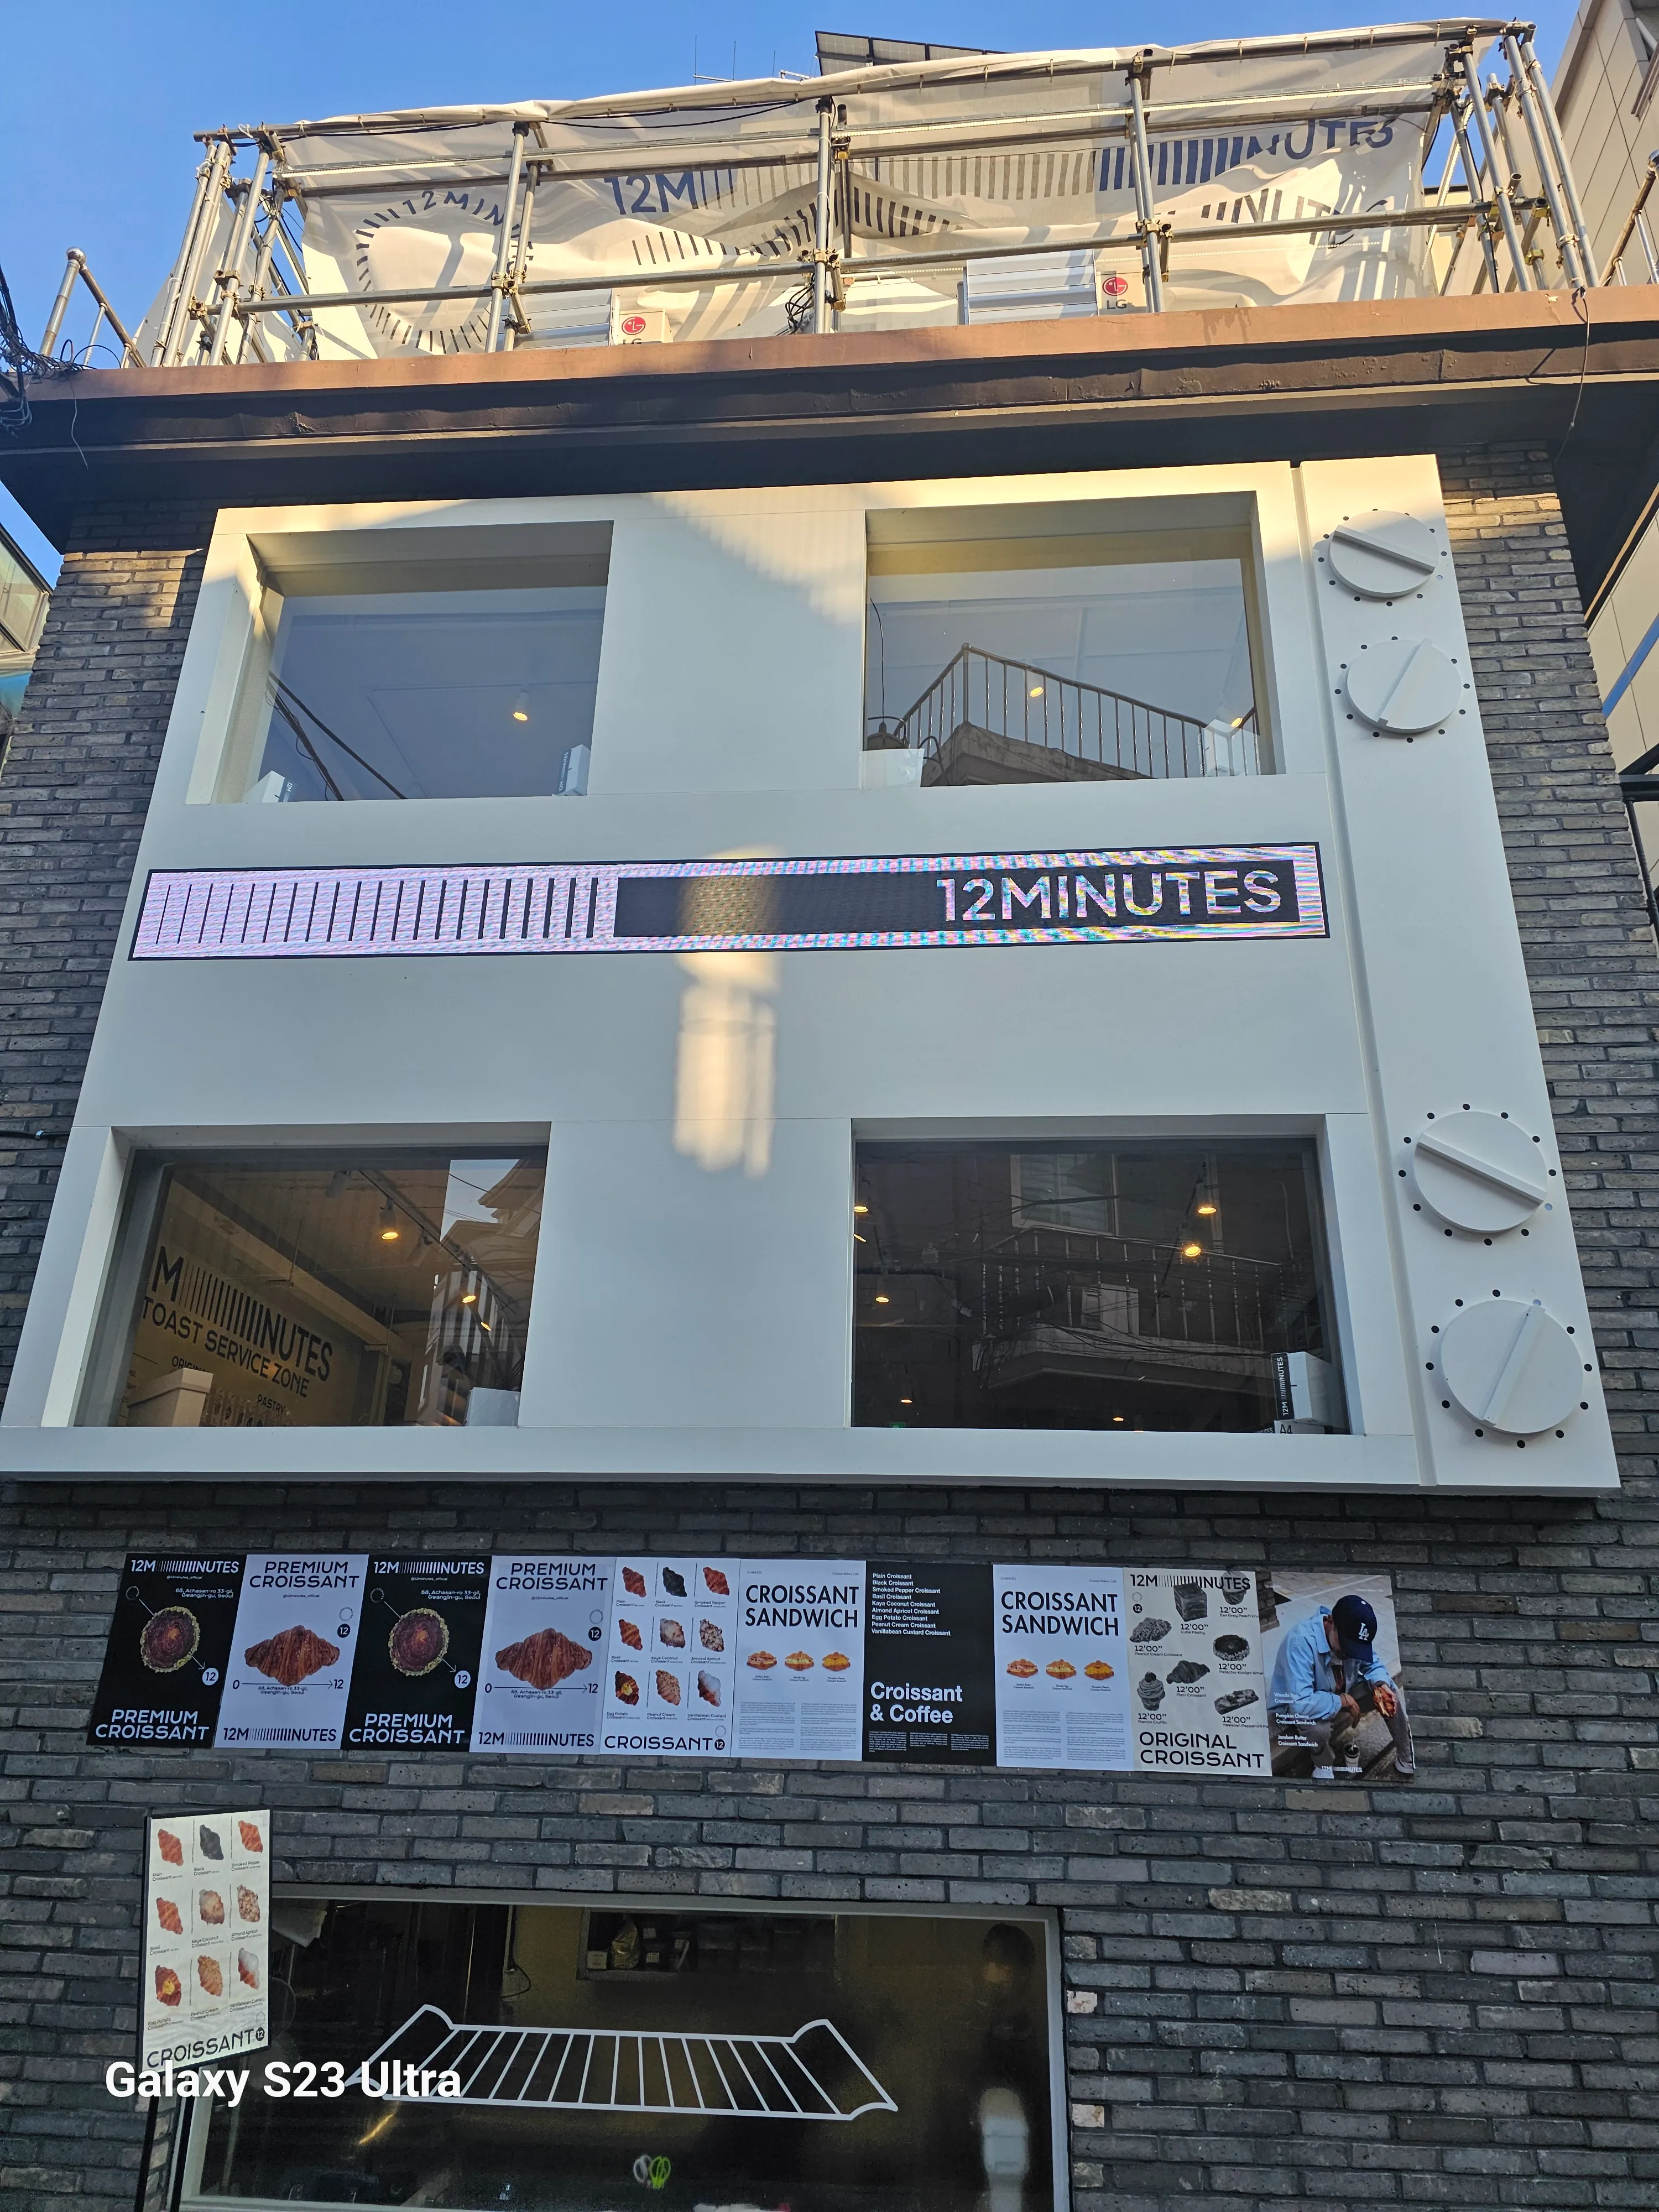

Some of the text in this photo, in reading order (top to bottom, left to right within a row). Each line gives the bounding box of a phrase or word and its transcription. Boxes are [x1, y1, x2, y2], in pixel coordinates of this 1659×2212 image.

[1107, 299, 1127, 310] LG
[937, 870, 1281, 921] 12MINUTES
[143, 1296, 310, 1398] TOAST SERVICE ZONE
[258, 1394, 285, 1413] PASTRY
[1280, 1424, 1293, 1434] A4
[265, 1561, 348, 1573] PREMIUM
[511, 1563, 596, 1575] PREMIUM
[249, 1575, 359, 1588] CROISSANT
[496, 1577, 608, 1590] CROISSANT
[746, 1585, 859, 1604] CROISSANT
[1001, 1591, 1118, 1612] CROISSANT
[745, 1608, 857, 1627] SANDWICH
[1002, 1615, 1118, 1636] SANDWICH
[1359, 1623, 1369, 1641] LA
[206, 1672, 216, 1681] 12
[334, 1679, 343, 1689] 12
[458, 1675, 468, 1684] 12
[588, 1683, 598, 1693] 12
[871, 1682, 963, 1702] Croissant
[112, 1709, 198, 1724] PREMIUM
[365, 1713, 452, 1728] PREMIUM
[870, 1704, 953, 1723] & Coffee
[96, 1724, 209, 1740] CROISSANT
[349, 1729, 465, 1744] CROISSANT
[604, 1736, 712, 1750] CROISSANT
[1140, 1731, 1237, 1749] ORIGINAL
[1140, 1750, 1264, 1768] CROISSANT
[147, 2028, 254, 2068] CROISSANT
